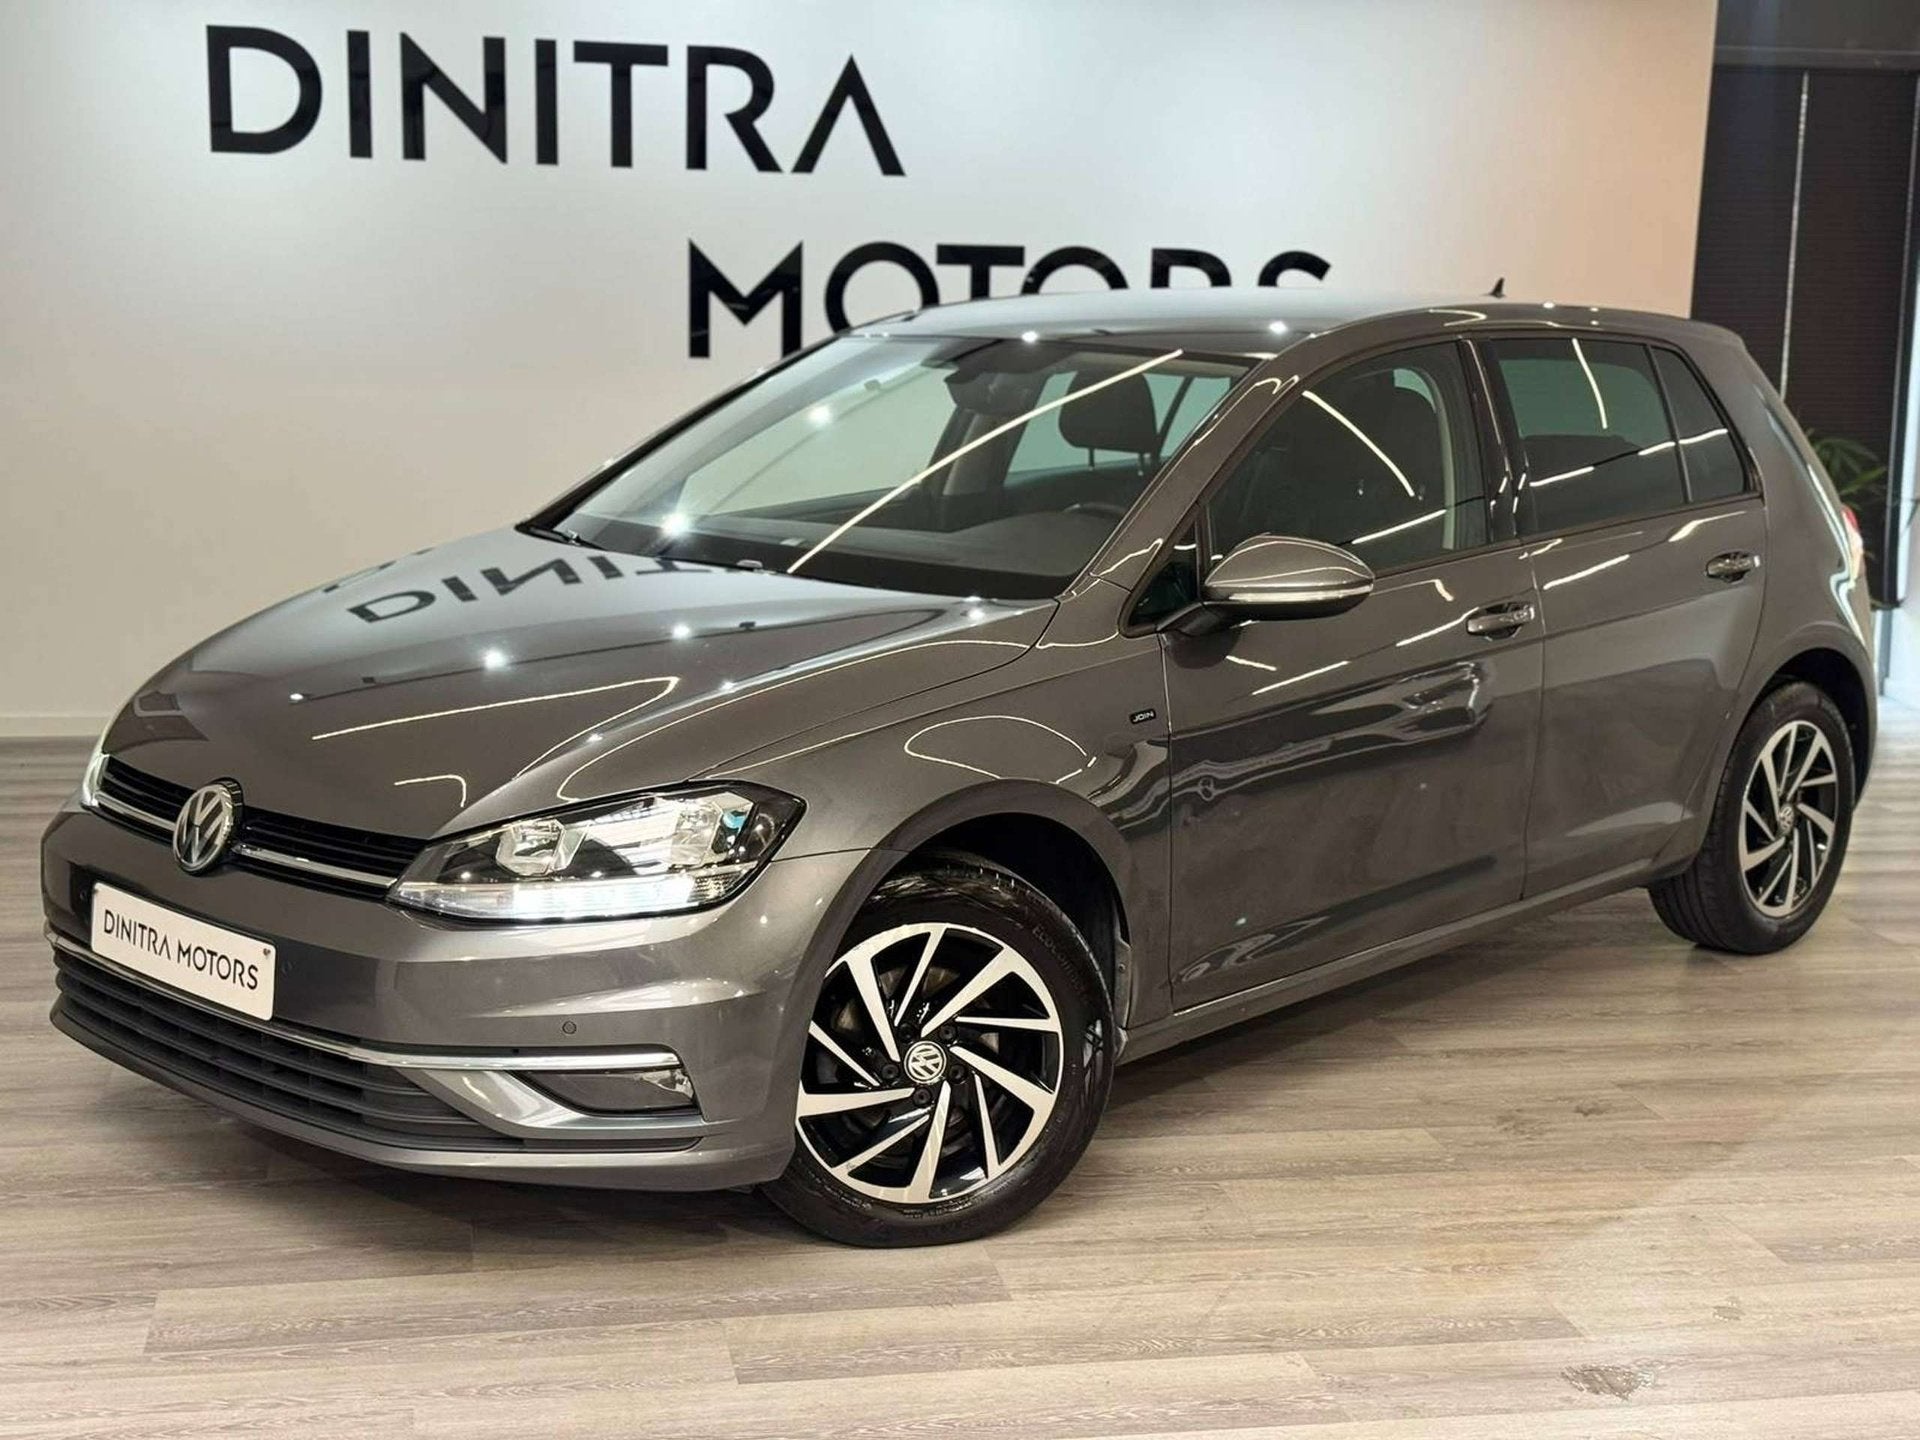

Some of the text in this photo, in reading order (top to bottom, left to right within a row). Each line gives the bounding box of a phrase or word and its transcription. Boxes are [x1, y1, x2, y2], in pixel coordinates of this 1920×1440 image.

[206, 25, 906, 177] DINITRA
[103, 909, 259, 990] DINITRA MOTORS
